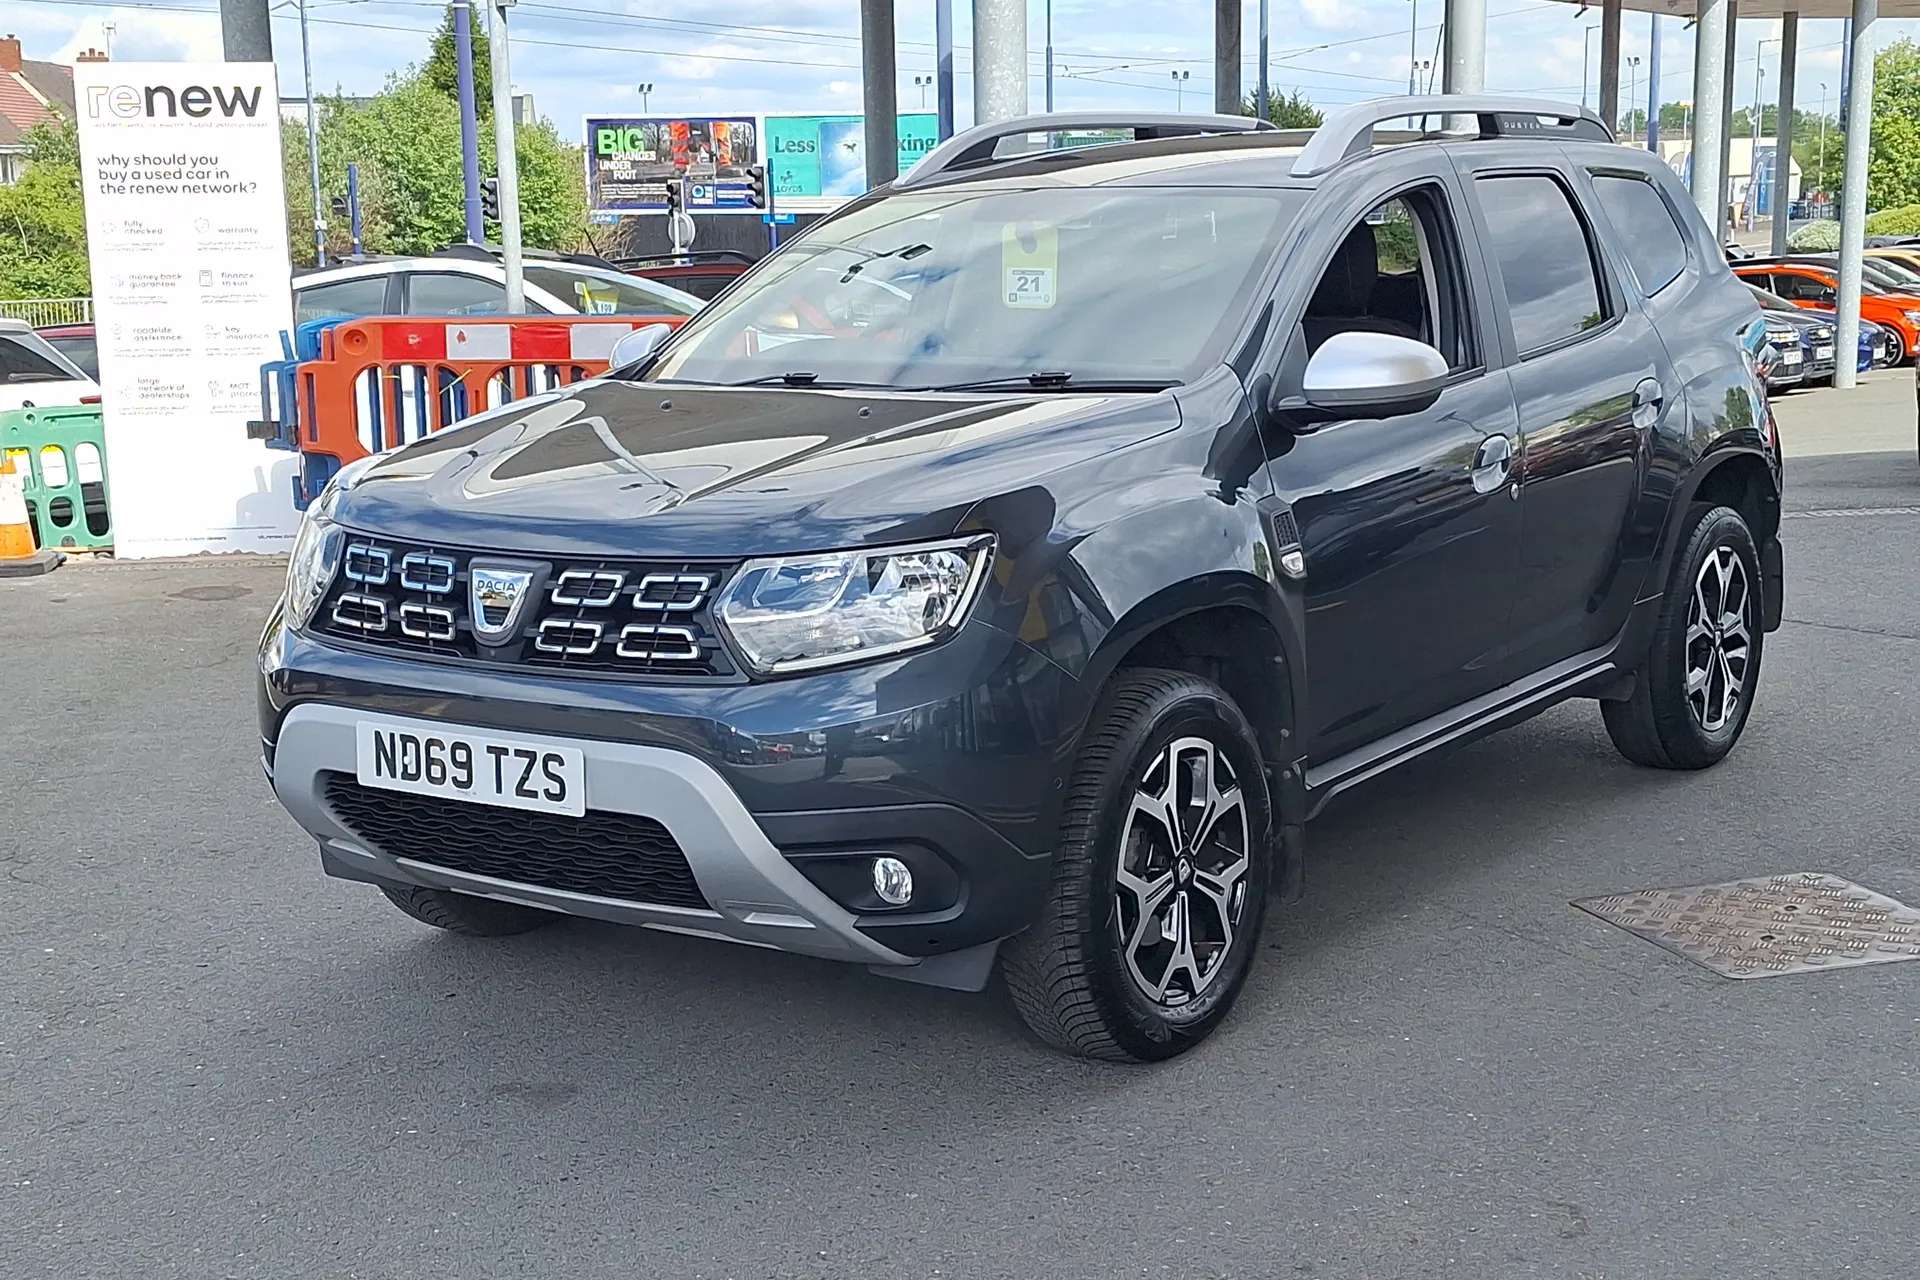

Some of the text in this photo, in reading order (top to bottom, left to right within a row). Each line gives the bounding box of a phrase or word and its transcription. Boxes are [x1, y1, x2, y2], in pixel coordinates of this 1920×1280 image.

[87, 85, 262, 118] renew
[597, 128, 645, 154] BIG
[775, 136, 816, 153] Less
[97, 153, 219, 169] why should you
[611, 151, 656, 161] CHANGES
[600, 161, 631, 170] UNDER
[98, 167, 230, 183] buy a used car in
[613, 170, 637, 180] FOOT
[100, 182, 257, 195] the renew network?
[123, 220, 143, 229] fully
[124, 227, 163, 235] checked
[128, 272, 182, 282] money back
[129, 280, 176, 289] guarantee
[1016, 276, 1040, 292] 21
[132, 326, 172, 334] roadside
[224, 325, 240, 334] key
[137, 376, 160, 386] large
[175, 383, 185, 391] of
[477, 579, 516, 592] DACIA
[373, 729, 567, 803] ND69 TZS
